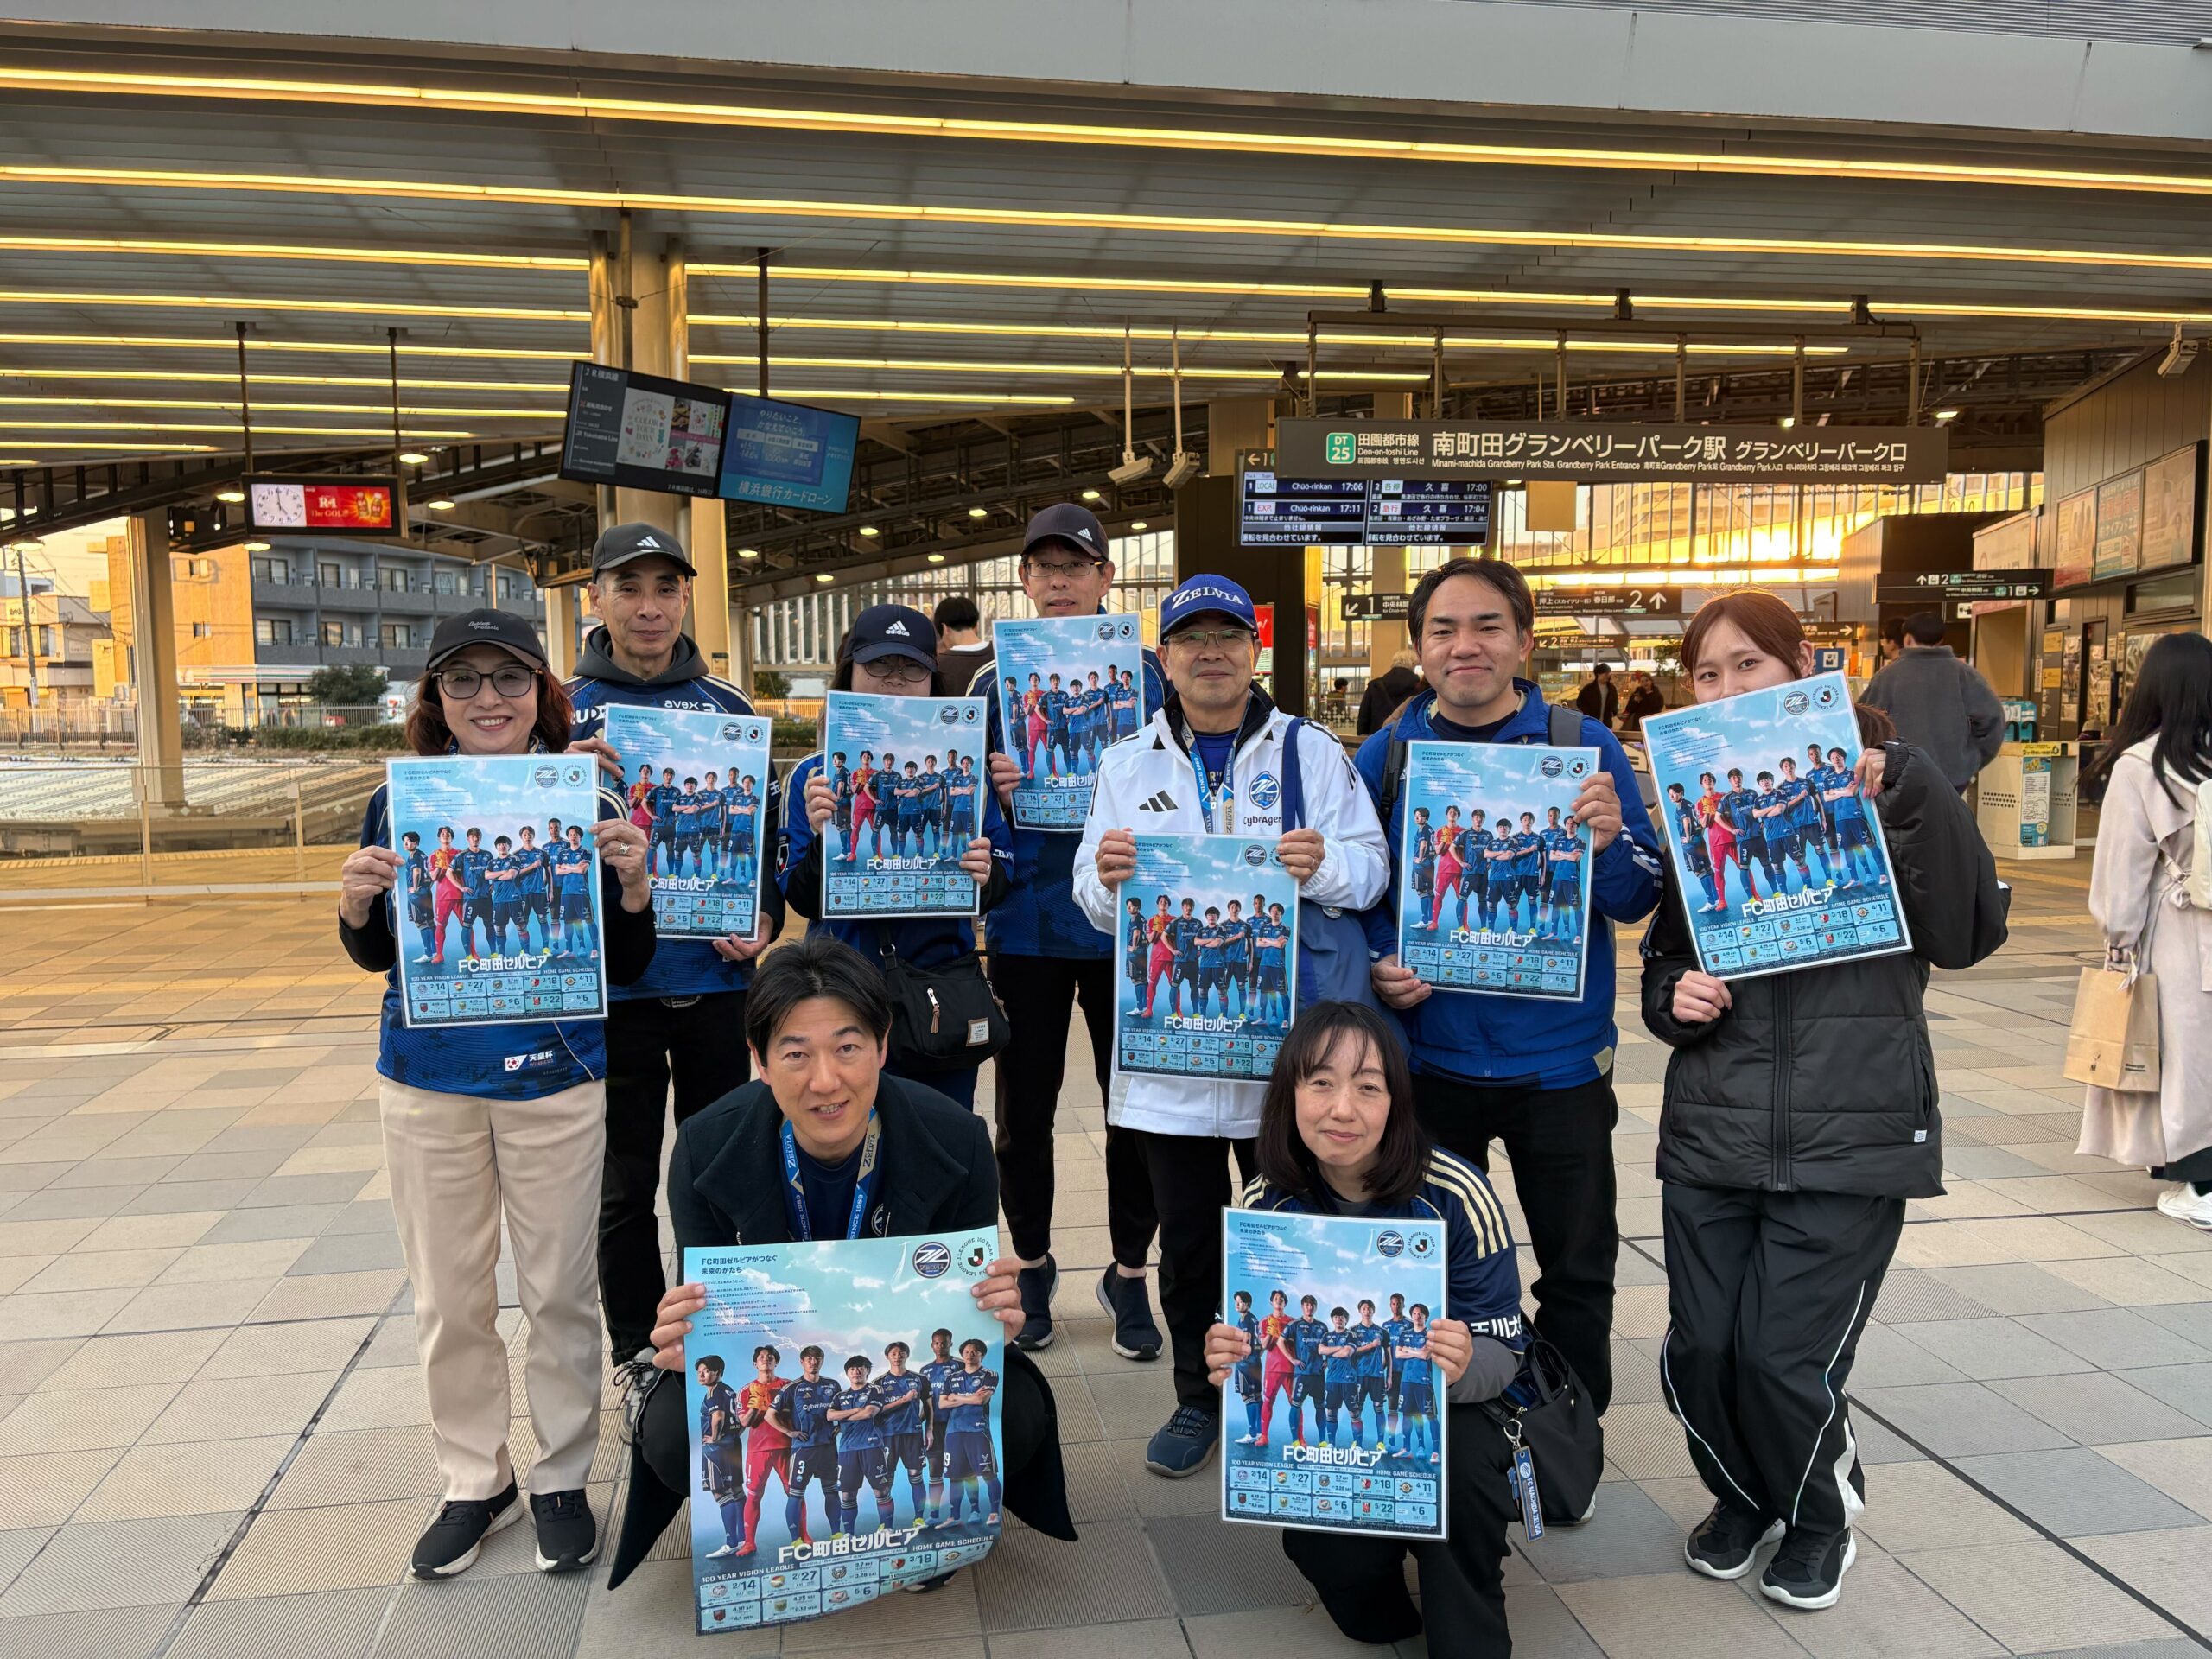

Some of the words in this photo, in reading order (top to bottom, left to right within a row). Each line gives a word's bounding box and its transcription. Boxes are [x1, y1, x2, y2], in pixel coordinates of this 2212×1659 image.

[1358, 433, 1419, 447] 田園都市線
[1358, 448, 1402, 456] Den-en-toshi
[1432, 432, 1726, 460] 南町田グランベリーパーク駅
[1734, 441, 1907, 461] グランベリーパーク口
[1332, 448, 1350, 460] 25
[1432, 459, 1485, 467] Minami-machida
[1488, 460, 1524, 470] Grandberry
[1526, 460, 1541, 468] Park
[1542, 460, 1556, 468] Sta.
[1557, 461, 1593, 471] Grandberry
[1611, 461, 1640, 470] Entrance
[1720, 462, 1756, 473] Grandberry
[1942, 574, 1948, 584] 2
[2009, 586, 2012, 595] 1
[1172, 587, 1244, 611] ZELVIA
[1368, 596, 1374, 614] 1
[1630, 590, 1642, 608] 2
[1551, 637, 1557, 645] 2
[664, 699, 699, 710] avex
[867, 858, 937, 870] FC町田ゼルビア
[647, 877, 715, 891] C町田ゼルビア
[1742, 887, 1834, 918] FC町田ゼルビア
[1862, 893, 1889, 903] SCHEDULE
[1450, 931, 1533, 946] FC町田ゼルビア
[458, 955, 548, 973] FC町田ゼルビア
[1164, 1016, 1243, 1033] FC町田ゼルビア
[529, 1050, 553, 1061] 天皇杯
[786, 1134, 796, 1168] ZELVIA
[864, 1134, 875, 1167] ZELVIA
[701, 1255, 778, 1266] FC町田ゼルビアがつなぐ
[1283, 1445, 1382, 1467] FC町田ゼルビア
[798, 1461, 805, 1474] 3
[1375, 1479, 1391, 1489] 3/18
[1416, 1483, 1431, 1491] 4/11
[779, 1526, 920, 1564] FC町田ゼルビア
[957, 1535, 994, 1547] SCHEDULE
[909, 1554, 932, 1563] 3/18
[739, 1568, 764, 1577] VISION
[766, 1564, 794, 1573] LEAGUE
[792, 1571, 817, 1581] 2/27
[733, 1580, 756, 1590] 2/14
[855, 1586, 871, 1596] 5/6
